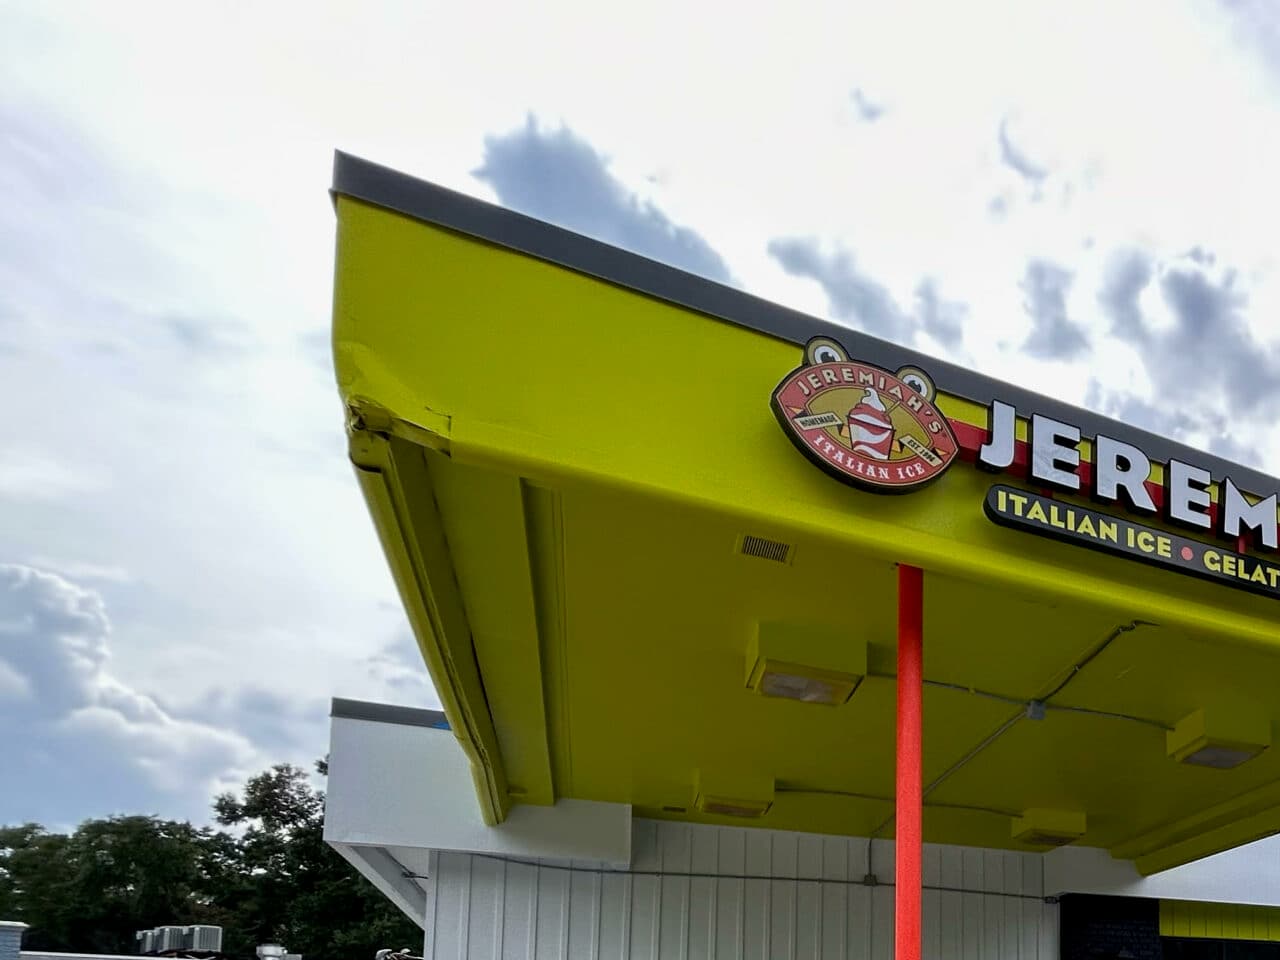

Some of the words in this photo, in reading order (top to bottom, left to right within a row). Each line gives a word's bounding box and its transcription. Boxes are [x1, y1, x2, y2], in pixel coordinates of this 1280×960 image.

[797, 367, 942, 434] JEREMIAH'S
[813, 434, 890, 480] ITALIAN
[897, 462, 926, 480] ICE
[997, 489, 1118, 544] ITALIAN
[1127, 527, 1172, 558] ICE
